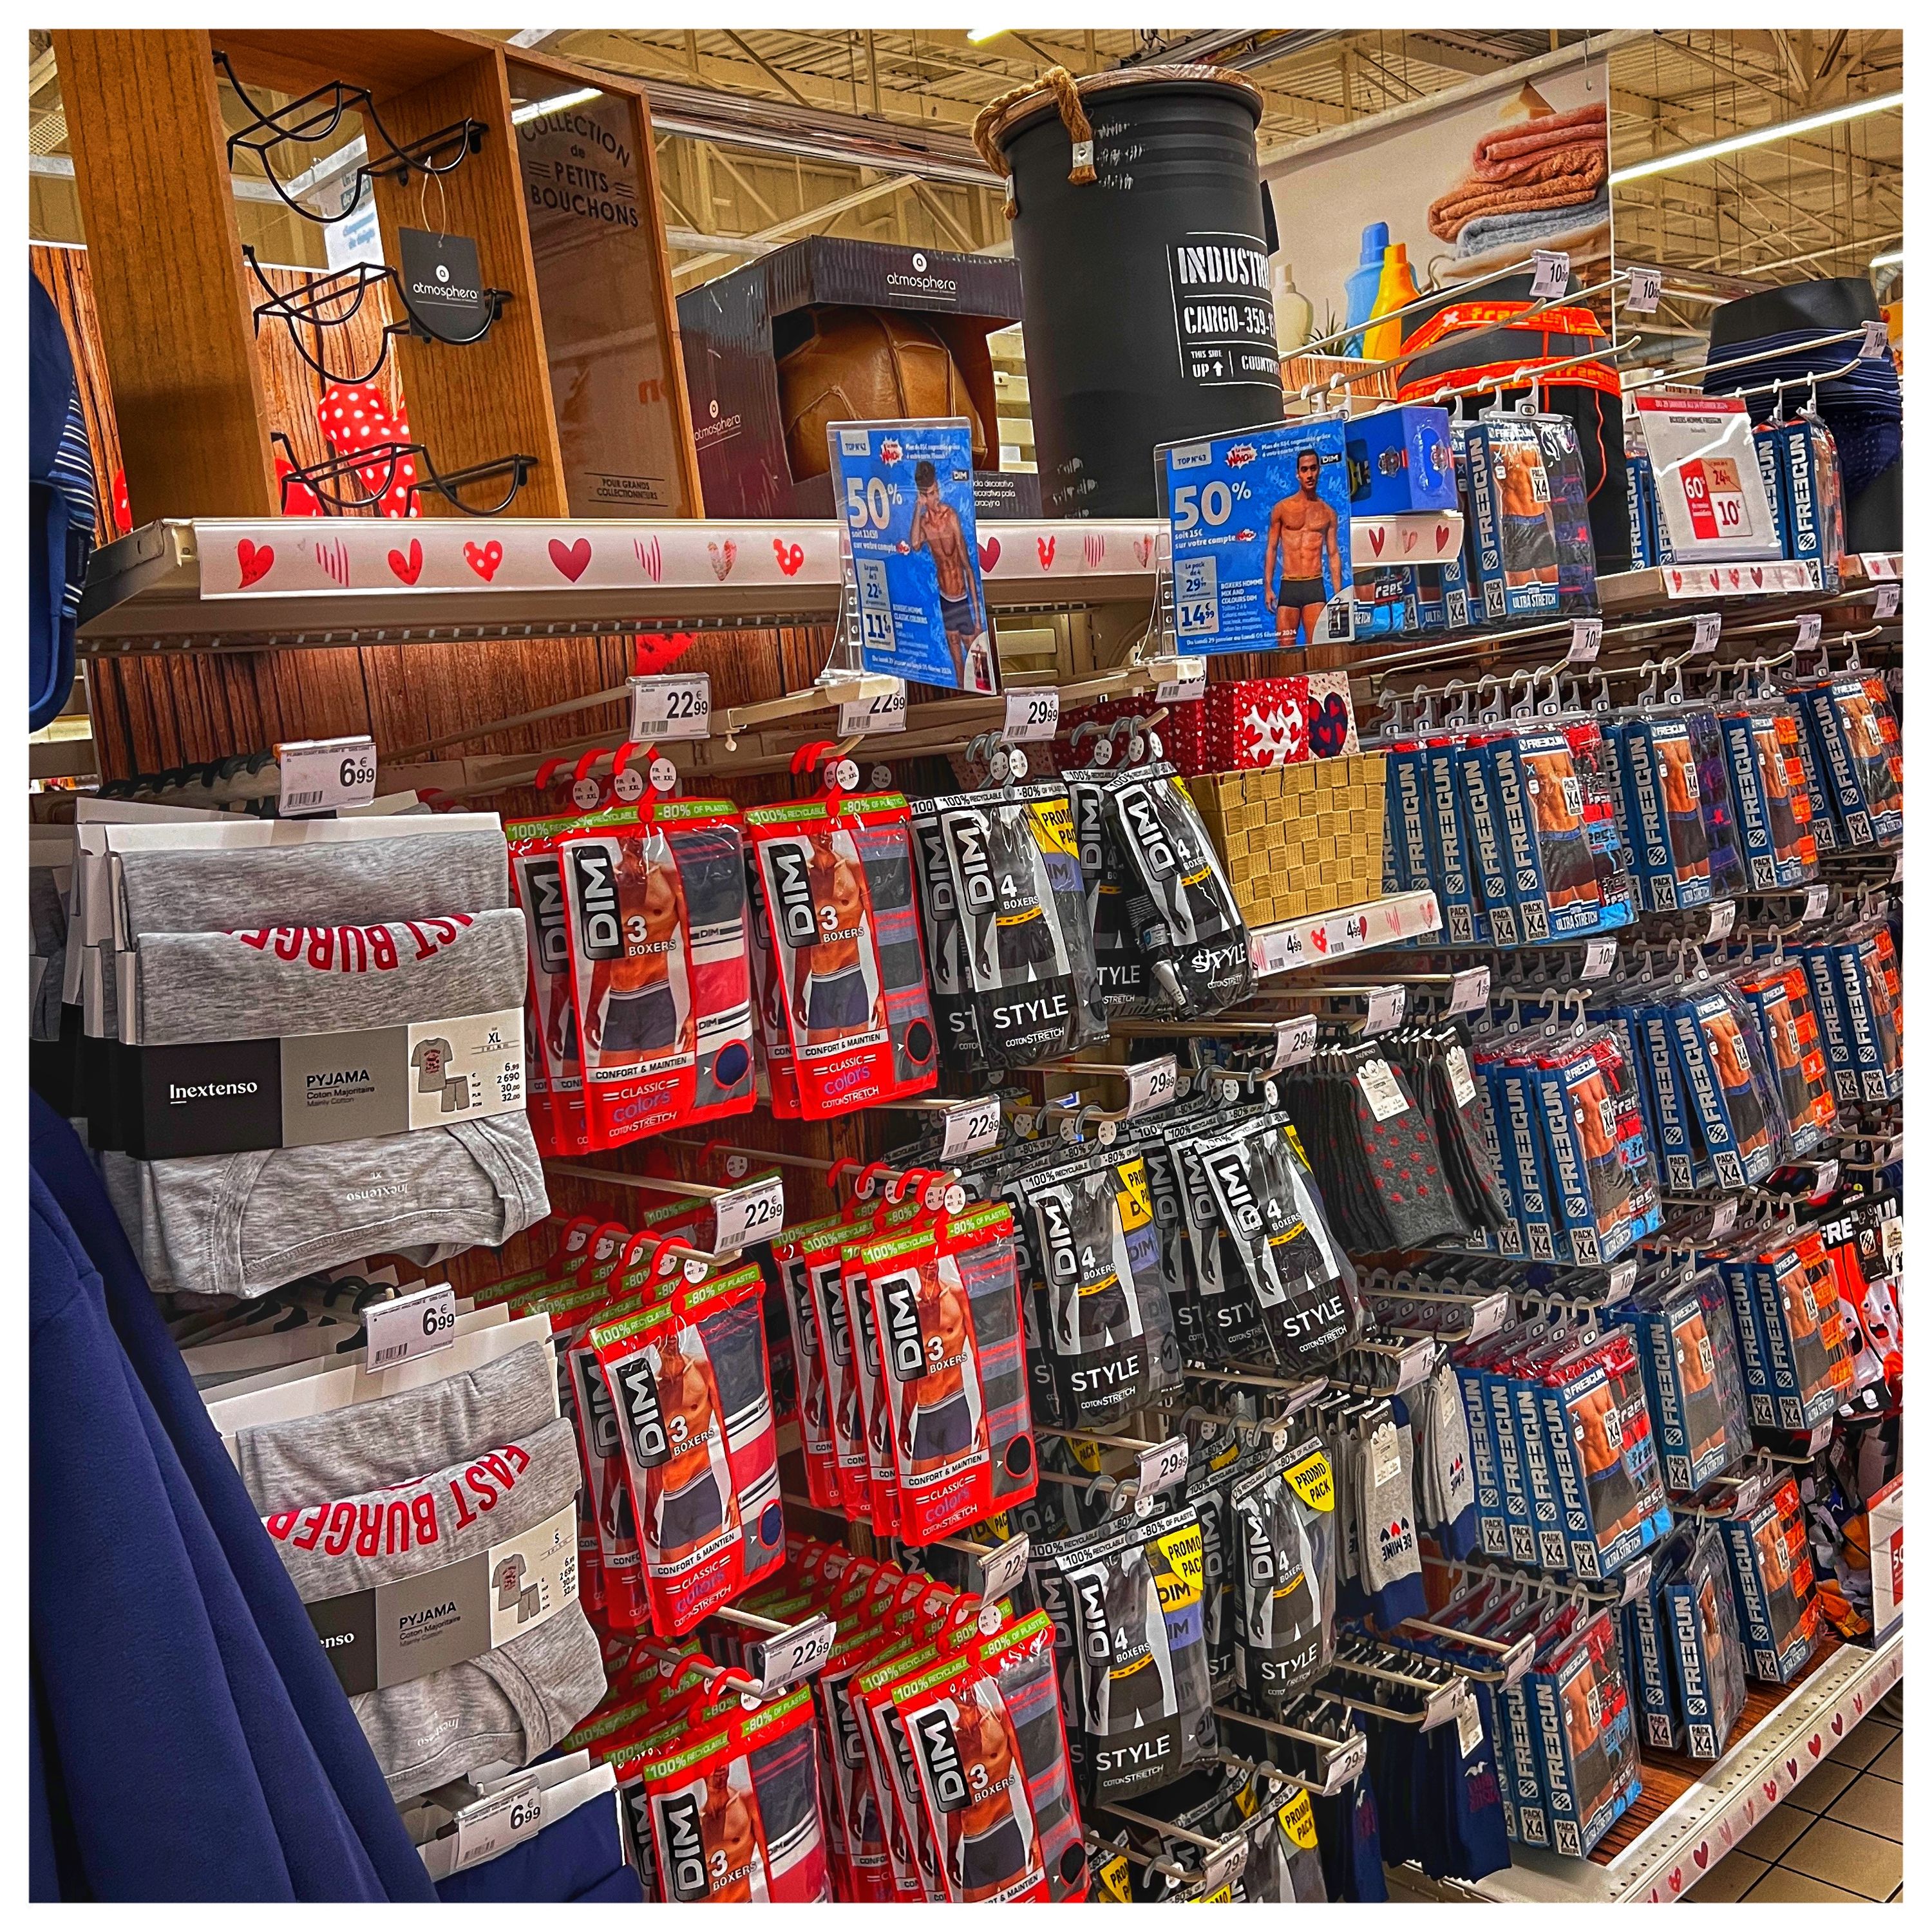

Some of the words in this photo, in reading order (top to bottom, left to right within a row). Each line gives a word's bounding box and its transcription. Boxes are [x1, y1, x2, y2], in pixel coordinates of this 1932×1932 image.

[520, 111, 630, 168] COLLECTION
[571, 143, 585, 159] de
[554, 161, 609, 193] PETITS
[530, 184, 639, 229] BOUCHONS
[413, 282, 478, 300] atmosphera
[886, 271, 957, 292] atmosphera
[1208, 350, 1223, 358] SIDE
[1192, 363, 1209, 377] UP
[694, 413, 741, 441] atmosphera
[623, 480, 650, 490] GRANDS
[1470, 437, 1496, 547] FREEGUN
[1174, 481, 1251, 531] 50%
[1175, 532, 1189, 541] soit
[1188, 538, 1206, 549] votre
[1208, 535, 1236, 547] compte
[1242, 578, 1264, 587] HOMME
[1486, 582, 1501, 592] PACK
[1487, 593, 1503, 612] X4
[1513, 595, 1530, 609] ULTRA
[1531, 594, 1556, 606] STRETCH
[1815, 696, 1851, 789] FREEGUN
[1629, 736, 1663, 845] FREEGUN
[1729, 728, 1759, 828] FREEGUN
[694, 805, 703, 813] OF
[970, 791, 1003, 802] RECYCLABLE
[1495, 750, 1533, 867] FREEGUN
[788, 807, 826, 817] RECYCLABLE
[1398, 763, 1426, 875] FREEGUN
[1432, 757, 1461, 871] FREEGUN
[1464, 760, 1501, 875] FREEGUN
[1128, 800, 1173, 873] DIM
[963, 828, 995, 905] DIM
[777, 854, 815, 937] DIM
[1001, 875, 1018, 897] 4
[581, 858, 619, 948] DIM
[1003, 896, 1039, 909] BOXERS
[1450, 908, 1467, 916] PACK
[1523, 904, 1542, 913] PACK
[627, 915, 648, 943] 3
[820, 905, 838, 931] 3
[1453, 916, 1470, 934] X4
[1527, 913, 1546, 931] X4
[823, 927, 864, 942] BOXERS
[629, 940, 676, 956] BOXERS
[993, 995, 1069, 1028] STYLE
[489, 1032, 501, 1044] XL
[806, 1043, 839, 1056] CONFORT
[847, 1033, 881, 1047] MAINTIEN
[596, 1067, 638, 1080] CONFORT
[649, 1056, 687, 1071] MAINTIEN
[829, 1056, 864, 1072] CLASSIC
[1647, 1019, 1679, 1124] FREEGUN
[1675, 1017, 1716, 1123] FREEGUN
[170, 1079, 258, 1099] Inextenso
[306, 1070, 370, 1088] PYJAMA
[307, 1090, 333, 1099] Coton
[334, 1084, 375, 1097] Majoritaire
[621, 1081, 666, 1099] CLASSIC
[824, 1065, 871, 1095] colors
[613, 1091, 671, 1122] colors
[1506, 1079, 1539, 1190] FREEGUN
[1716, 1154, 1735, 1164] PACK
[1218, 1162, 1263, 1233] DIM
[897, 1234, 935, 1250] RECYCLABLE
[985, 1209, 1007, 1222] PLASTIC
[1044, 1204, 1077, 1276] DIM
[1081, 1245, 1095, 1268] 4
[1578, 1240, 1597, 1258] X4
[1084, 1262, 1116, 1280] BOXERS
[630, 1308, 670, 1333] RECYCLABLE
[728, 1271, 755, 1287] PLASTIC
[889, 1289, 923, 1370] DIM
[1282, 1296, 1345, 1338] STYLE
[928, 1335, 944, 1361] 3
[929, 1352, 967, 1374] BOXERS
[1072, 1355, 1140, 1392] STYLE
[625, 1369, 667, 1457] DIM
[673, 1428, 714, 1457] BOXERS
[909, 1471, 943, 1486] CONFORT
[952, 1454, 982, 1473] MAINTIEN
[1294, 1463, 1327, 1489] PROMO
[930, 1477, 965, 1501] CLASSIC
[1309, 1482, 1331, 1502] PACK
[1167, 1536, 1201, 1561] PROMO
[1247, 1515, 1274, 1582] DIM
[1578, 1552, 1596, 1571] X4
[399, 1601, 457, 1629] PYJAMA
[1084, 1583, 1112, 1658] DIM
[1115, 1627, 1129, 1650] 4
[1116, 1642, 1151, 1663] BOXERS
[1261, 1643, 1318, 1680] STYLE
[782, 1692, 808, 1713] PLASTIC
[924, 1719, 965, 1803] DIM
[1095, 1734, 1171, 1772] STYLE
[974, 1774, 1016, 1803] BOXERS
[1284, 1799, 1310, 1828] PROMO
[1296, 1820, 1314, 1841] PACK
[668, 1804, 705, 1891] DIM
[714, 1861, 757, 1891] BOXERS
